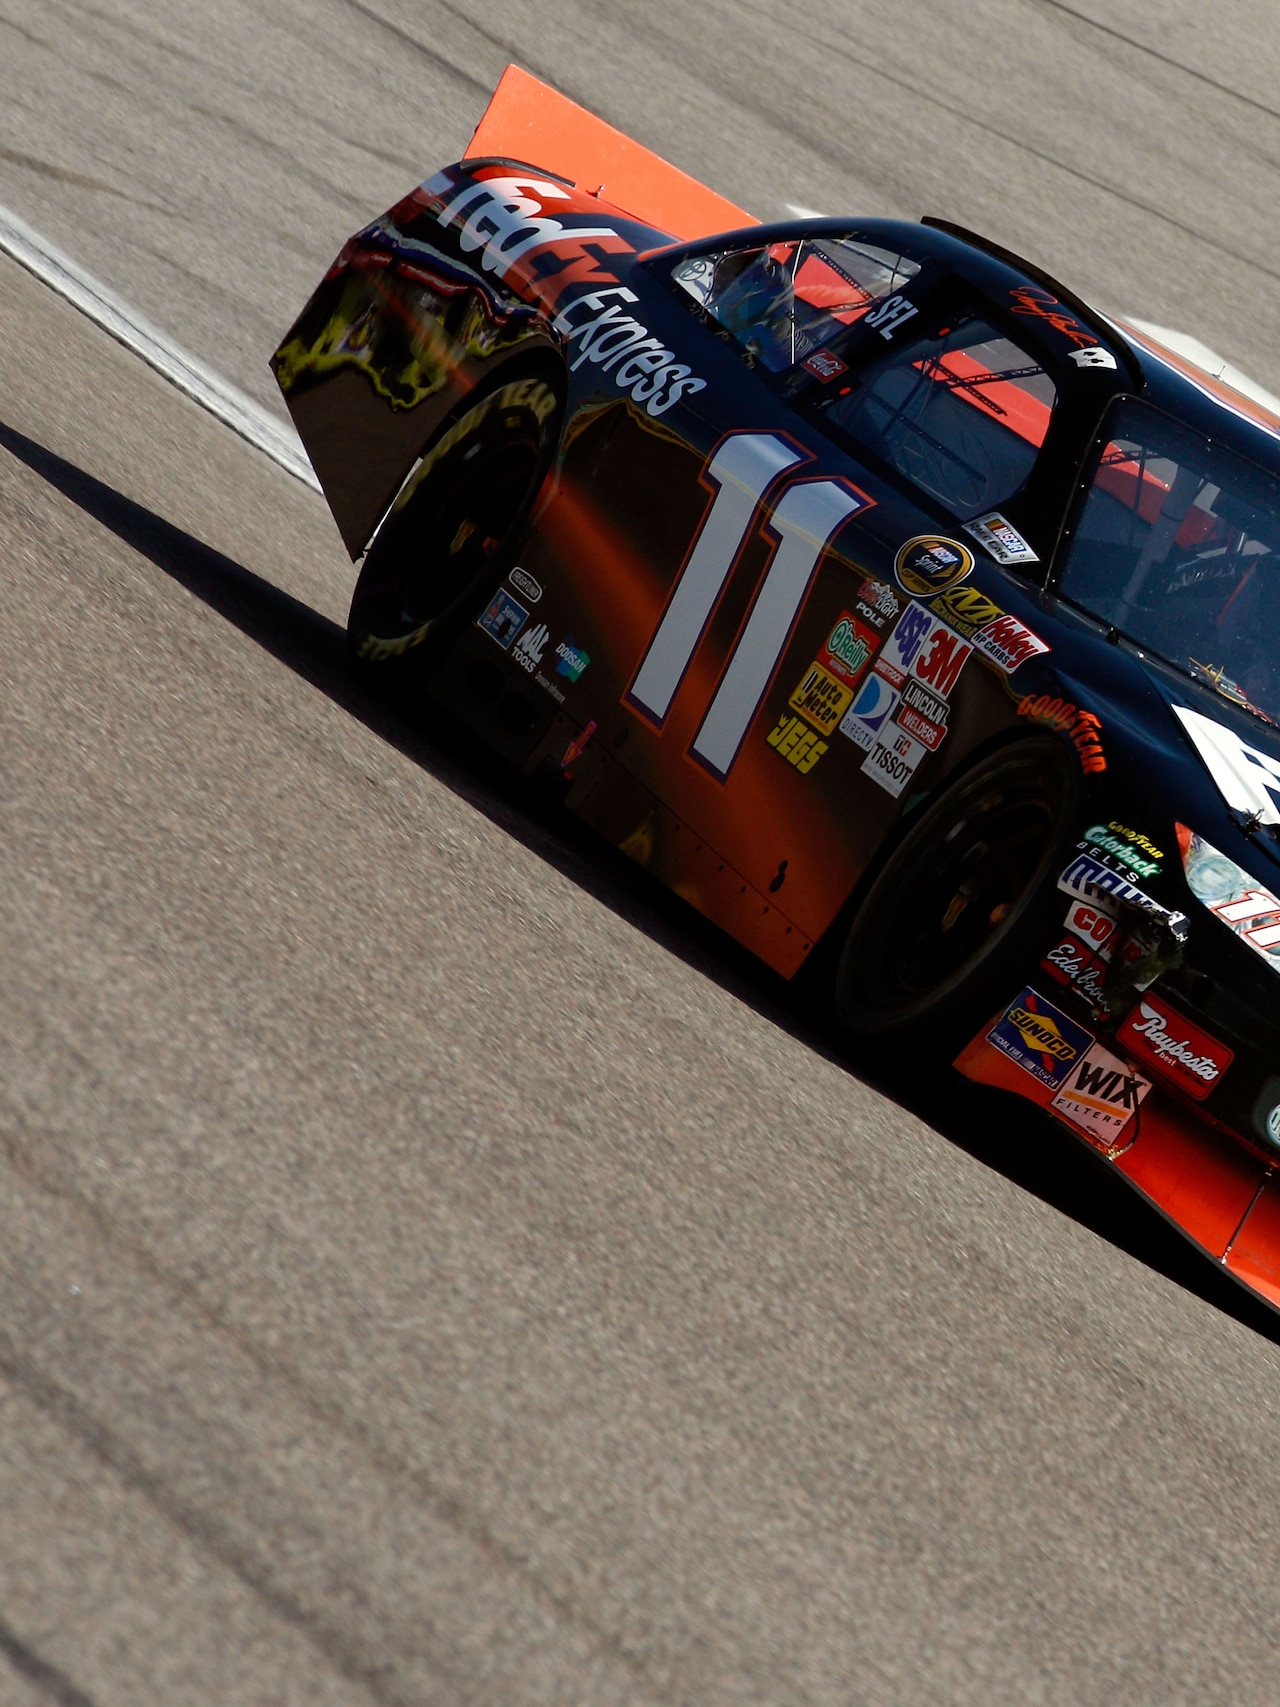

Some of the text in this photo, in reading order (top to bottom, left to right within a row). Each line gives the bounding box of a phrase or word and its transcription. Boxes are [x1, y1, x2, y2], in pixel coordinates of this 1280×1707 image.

[438, 177, 634, 318] FedEx
[864, 295, 919, 341] SFL
[554, 286, 707, 417] Express
[915, 554, 946, 576] Sprint
[619, 429, 877, 785] 11
[856, 601, 886, 628] POLE
[876, 591, 900, 622] LIGHT
[511, 645, 536, 674] TOOLS
[516, 623, 551, 665] MAC
[555, 642, 587, 675] DOOSAN
[974, 632, 1011, 666] HP CARBS
[981, 615, 1038, 667] Holley
[916, 629, 973, 696] 3M
[802, 690, 838, 726] Meter
[814, 671, 843, 706] Auto
[904, 681, 947, 726] LINCOLN
[766, 716, 829, 775] JEGS
[841, 718, 874, 751] DIRECTV
[902, 711, 938, 745] WELDERS
[870, 739, 914, 785] TISSOT
[1085, 826, 1163, 878] Gatorback
[1108, 820, 1164, 860] GOODYEAR
[1076, 841, 1140, 884] BELTS
[1007, 1008, 1074, 1061] SUNOCO
[1131, 1000, 1220, 1082] Raybestos
[1158, 1051, 1176, 1068] best
[1075, 1060, 1141, 1109] WIX
[1055, 1098, 1122, 1127] FILTERS
